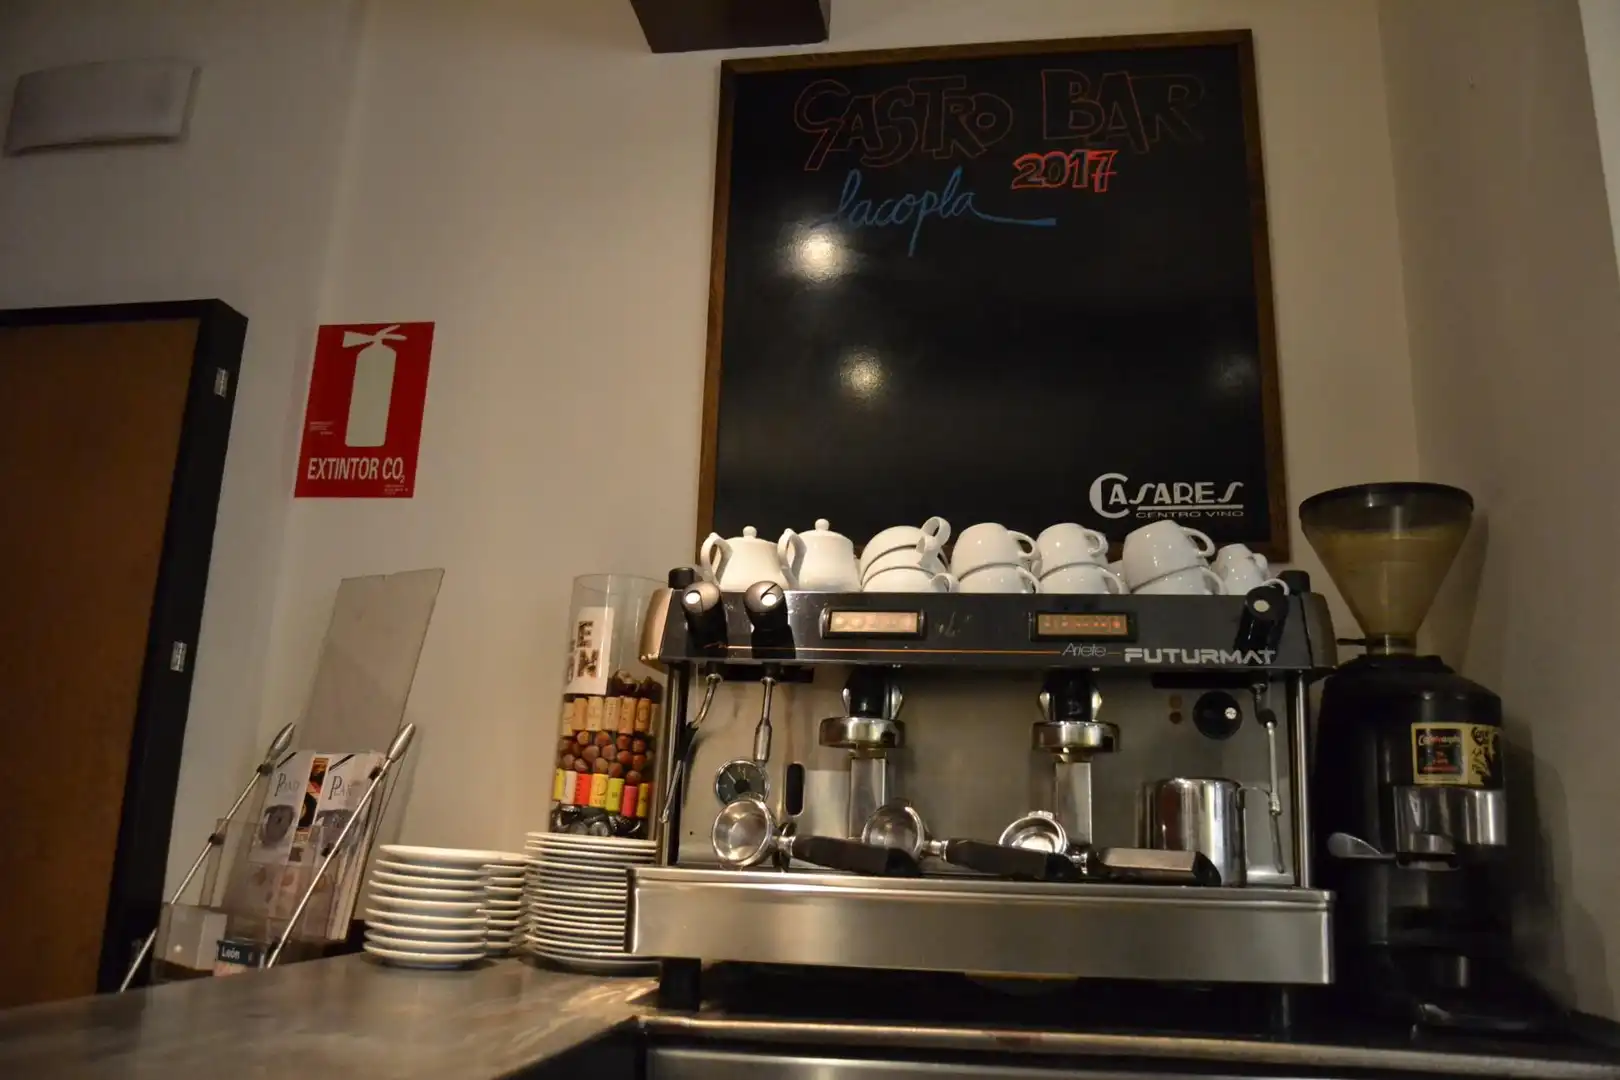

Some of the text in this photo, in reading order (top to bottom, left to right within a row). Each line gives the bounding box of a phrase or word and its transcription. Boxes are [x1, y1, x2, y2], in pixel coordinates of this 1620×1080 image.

[793, 69, 1205, 172] GASTRO BAR
[1010, 148, 1120, 193] 2017
[307, 456, 379, 480] EXTINTOR
[1089, 472, 1244, 519] CASARES
[1136, 510, 1244, 519] CENTRO VINO
[1061, 642, 1107, 658] Ariete
[1124, 647, 1276, 665] FUTURMAT
